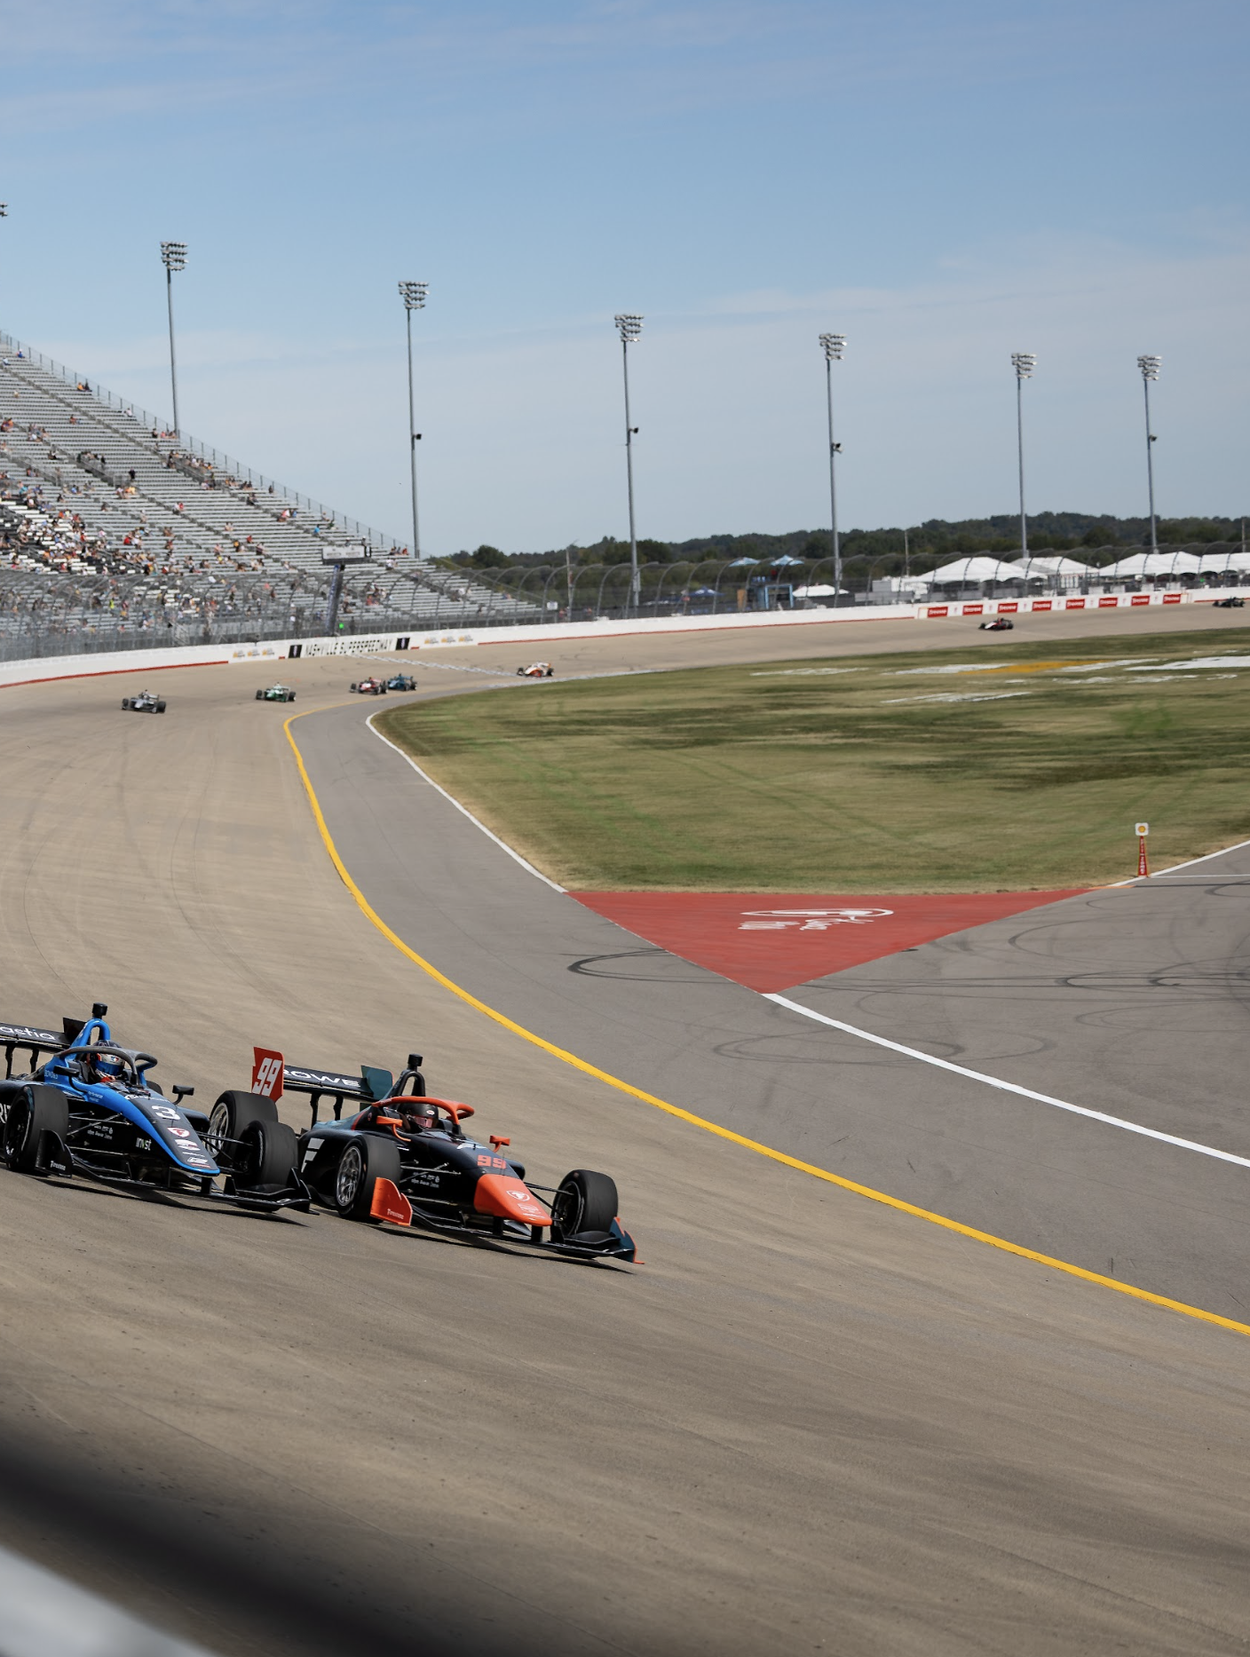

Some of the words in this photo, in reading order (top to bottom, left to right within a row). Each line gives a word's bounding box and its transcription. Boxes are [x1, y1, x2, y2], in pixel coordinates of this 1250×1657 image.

[252, 1057, 283, 1097] 99
[151, 1105, 181, 1120] 3
[477, 1154, 507, 1170] 99
